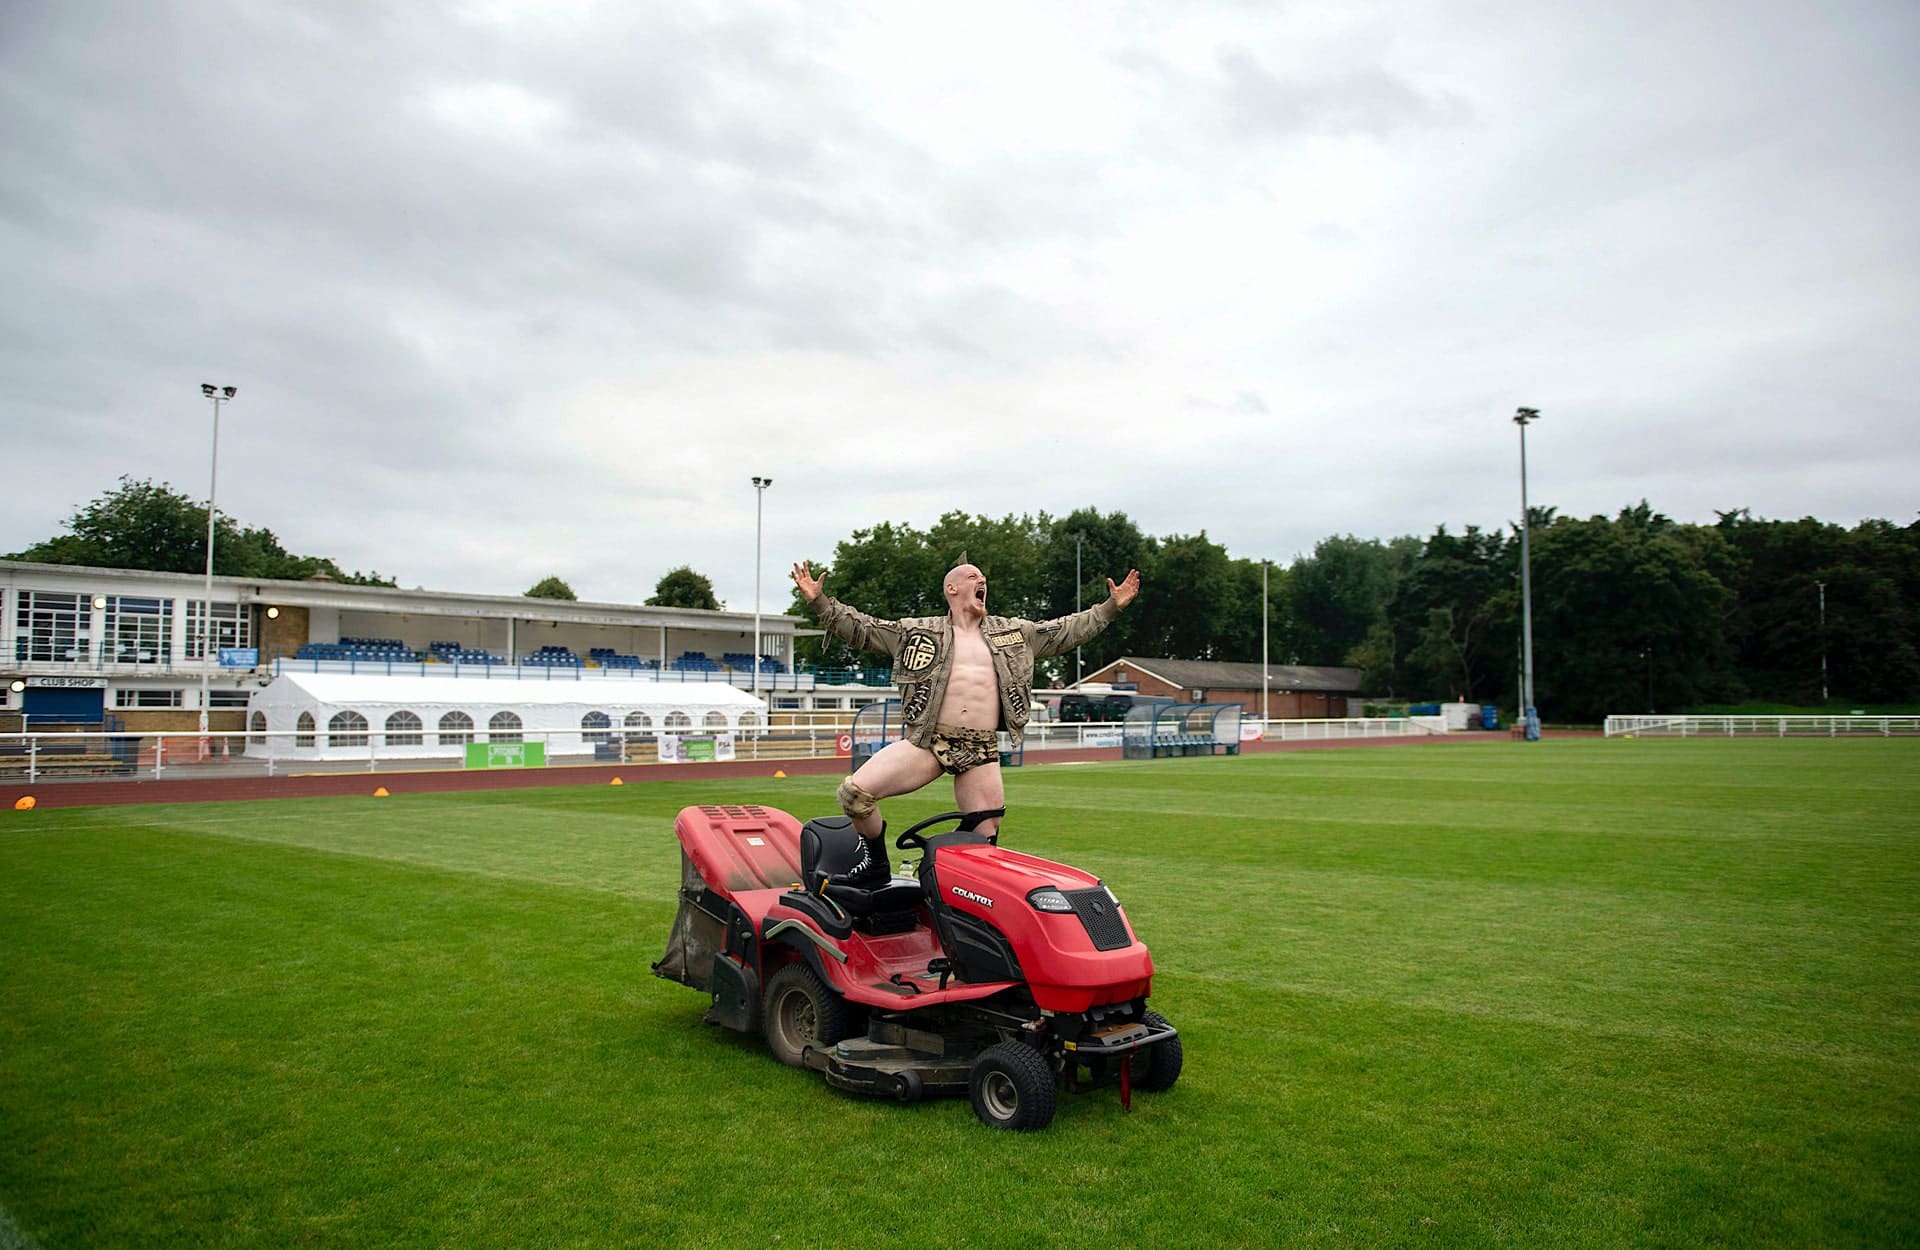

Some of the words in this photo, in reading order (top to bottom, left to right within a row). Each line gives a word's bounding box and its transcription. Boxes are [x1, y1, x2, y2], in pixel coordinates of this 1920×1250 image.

[40, 678, 66, 686] CLUB
[67, 678, 95, 687] SHOP
[952, 886, 993, 908] COUNTAX
